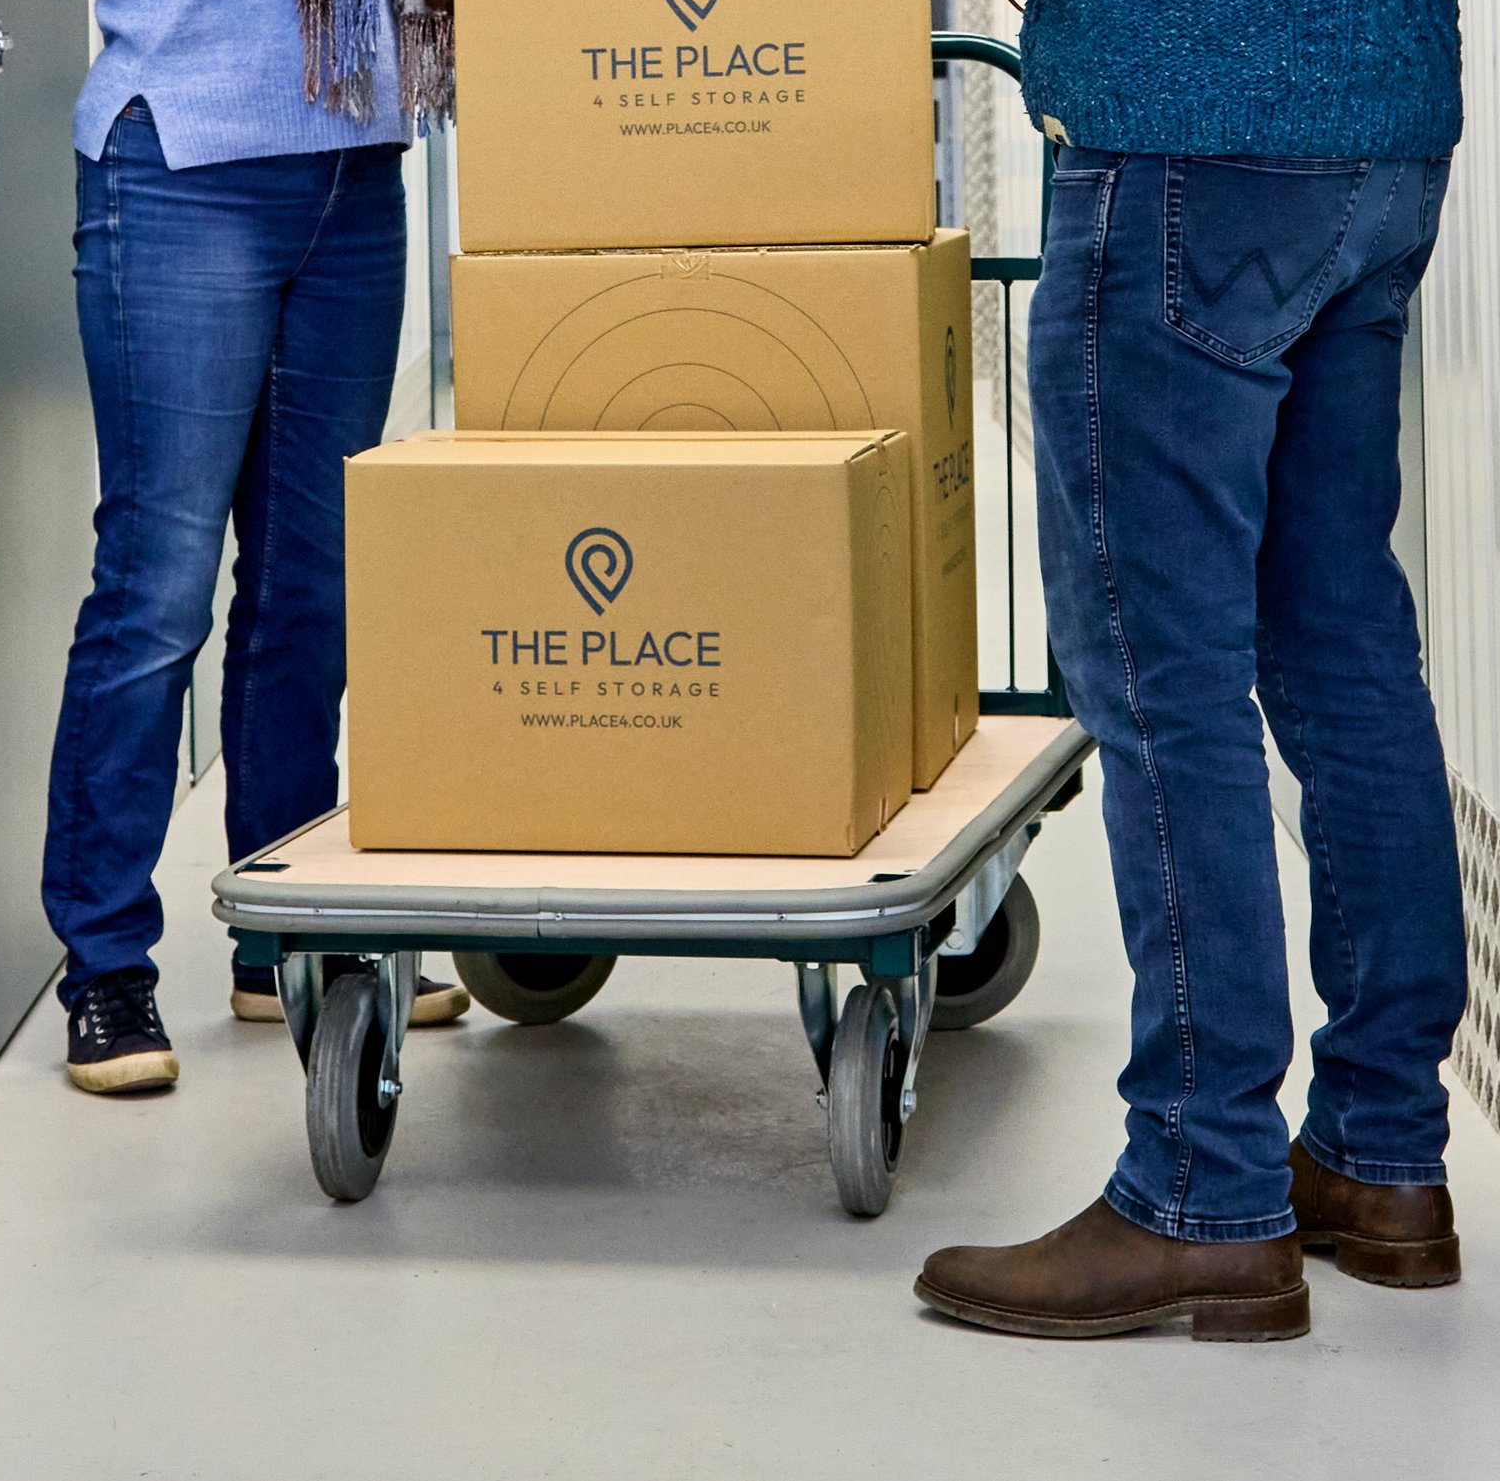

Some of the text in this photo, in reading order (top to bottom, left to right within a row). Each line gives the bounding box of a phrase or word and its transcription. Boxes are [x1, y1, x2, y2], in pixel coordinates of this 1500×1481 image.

[581, 42, 806, 80] THE PLACE
[593, 89, 805, 108] 4 SELF STORAGE
[620, 120, 771, 136] WWW.PLACE4.CO.UK
[481, 630, 721, 667] THE PLACE
[492, 681, 720, 697] 4 SELF STORAGE
[520, 714, 683, 729] WWW.PLACE4.CO.UK
